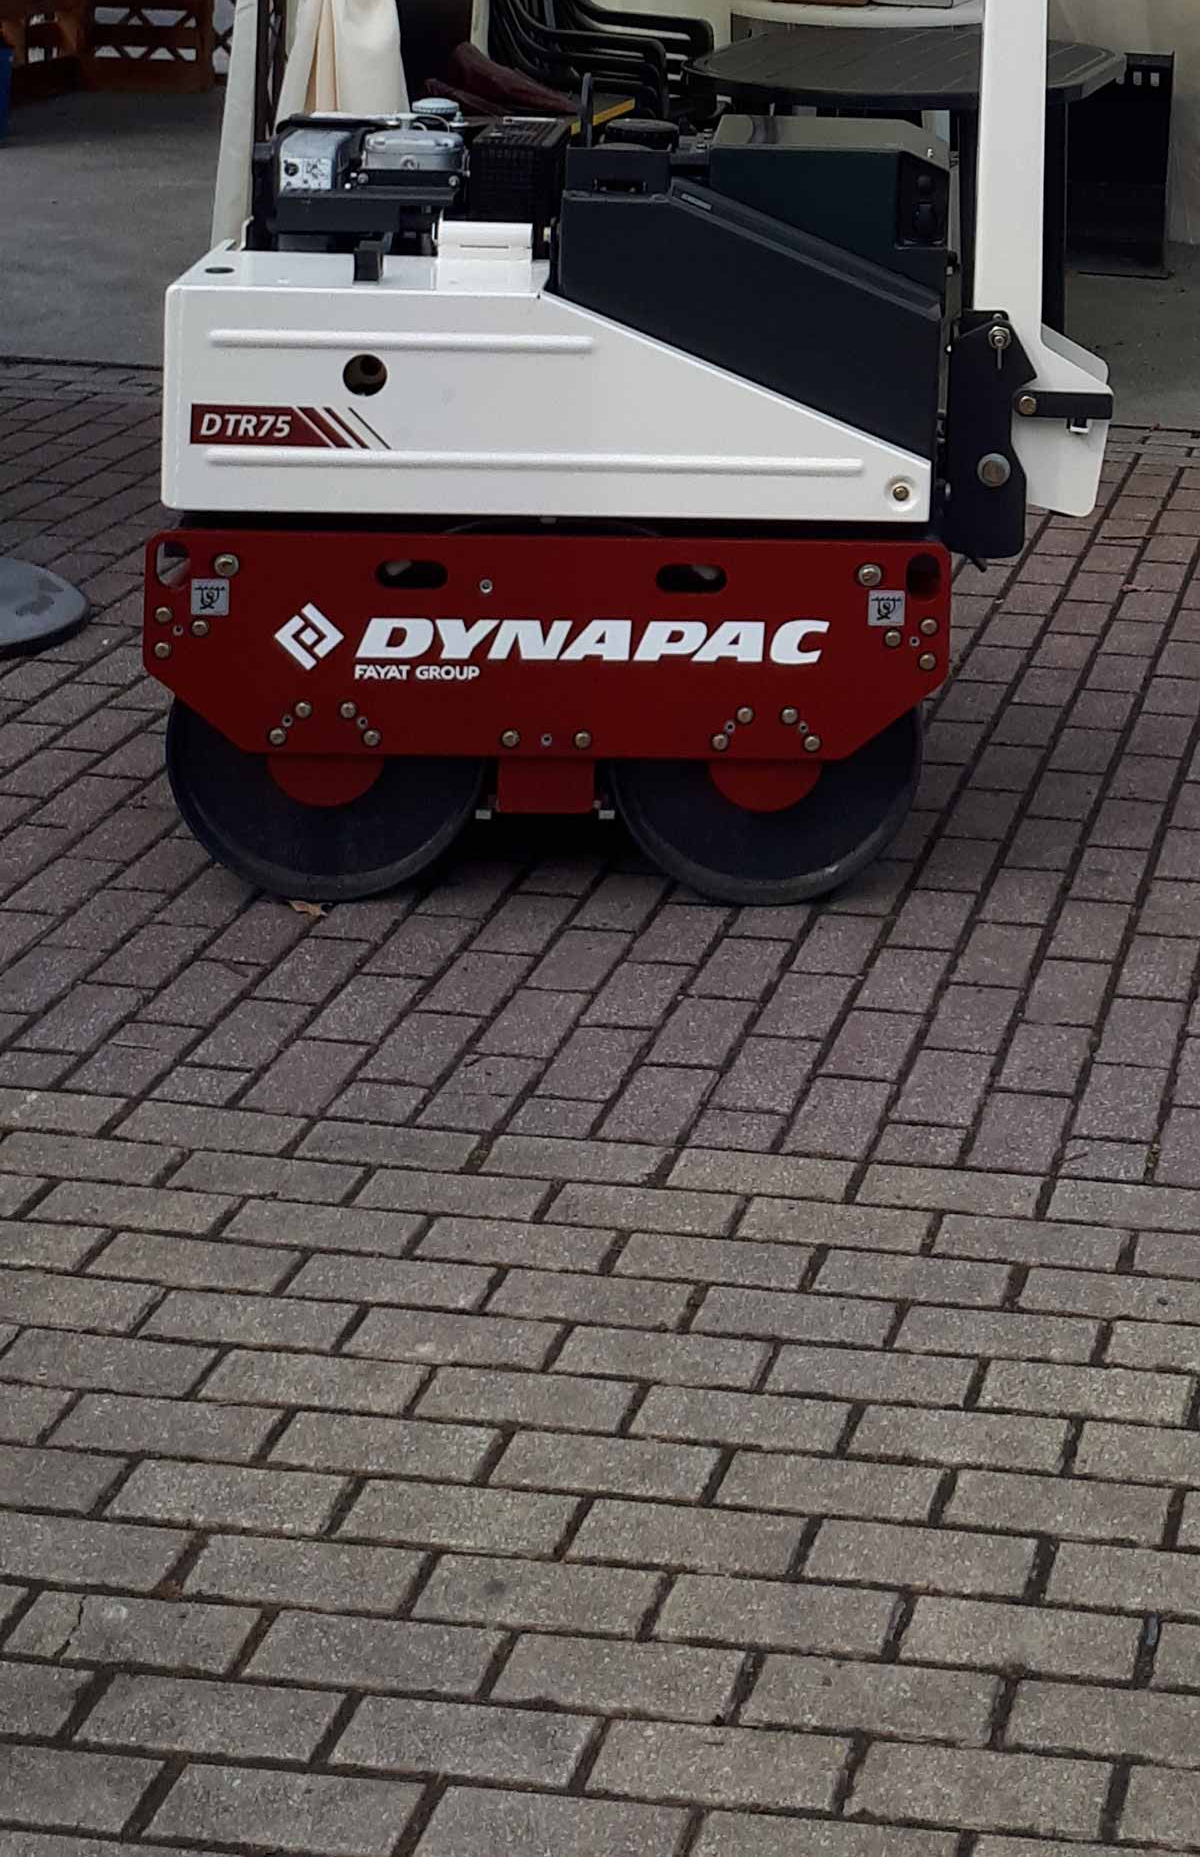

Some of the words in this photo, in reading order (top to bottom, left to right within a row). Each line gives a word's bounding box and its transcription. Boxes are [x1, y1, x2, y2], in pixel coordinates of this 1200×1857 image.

[200, 413, 292, 438] DTR75
[354, 617, 830, 665] DYNAPAC
[354, 665, 411, 680] FAYAT
[415, 665, 480, 680] GROUP
